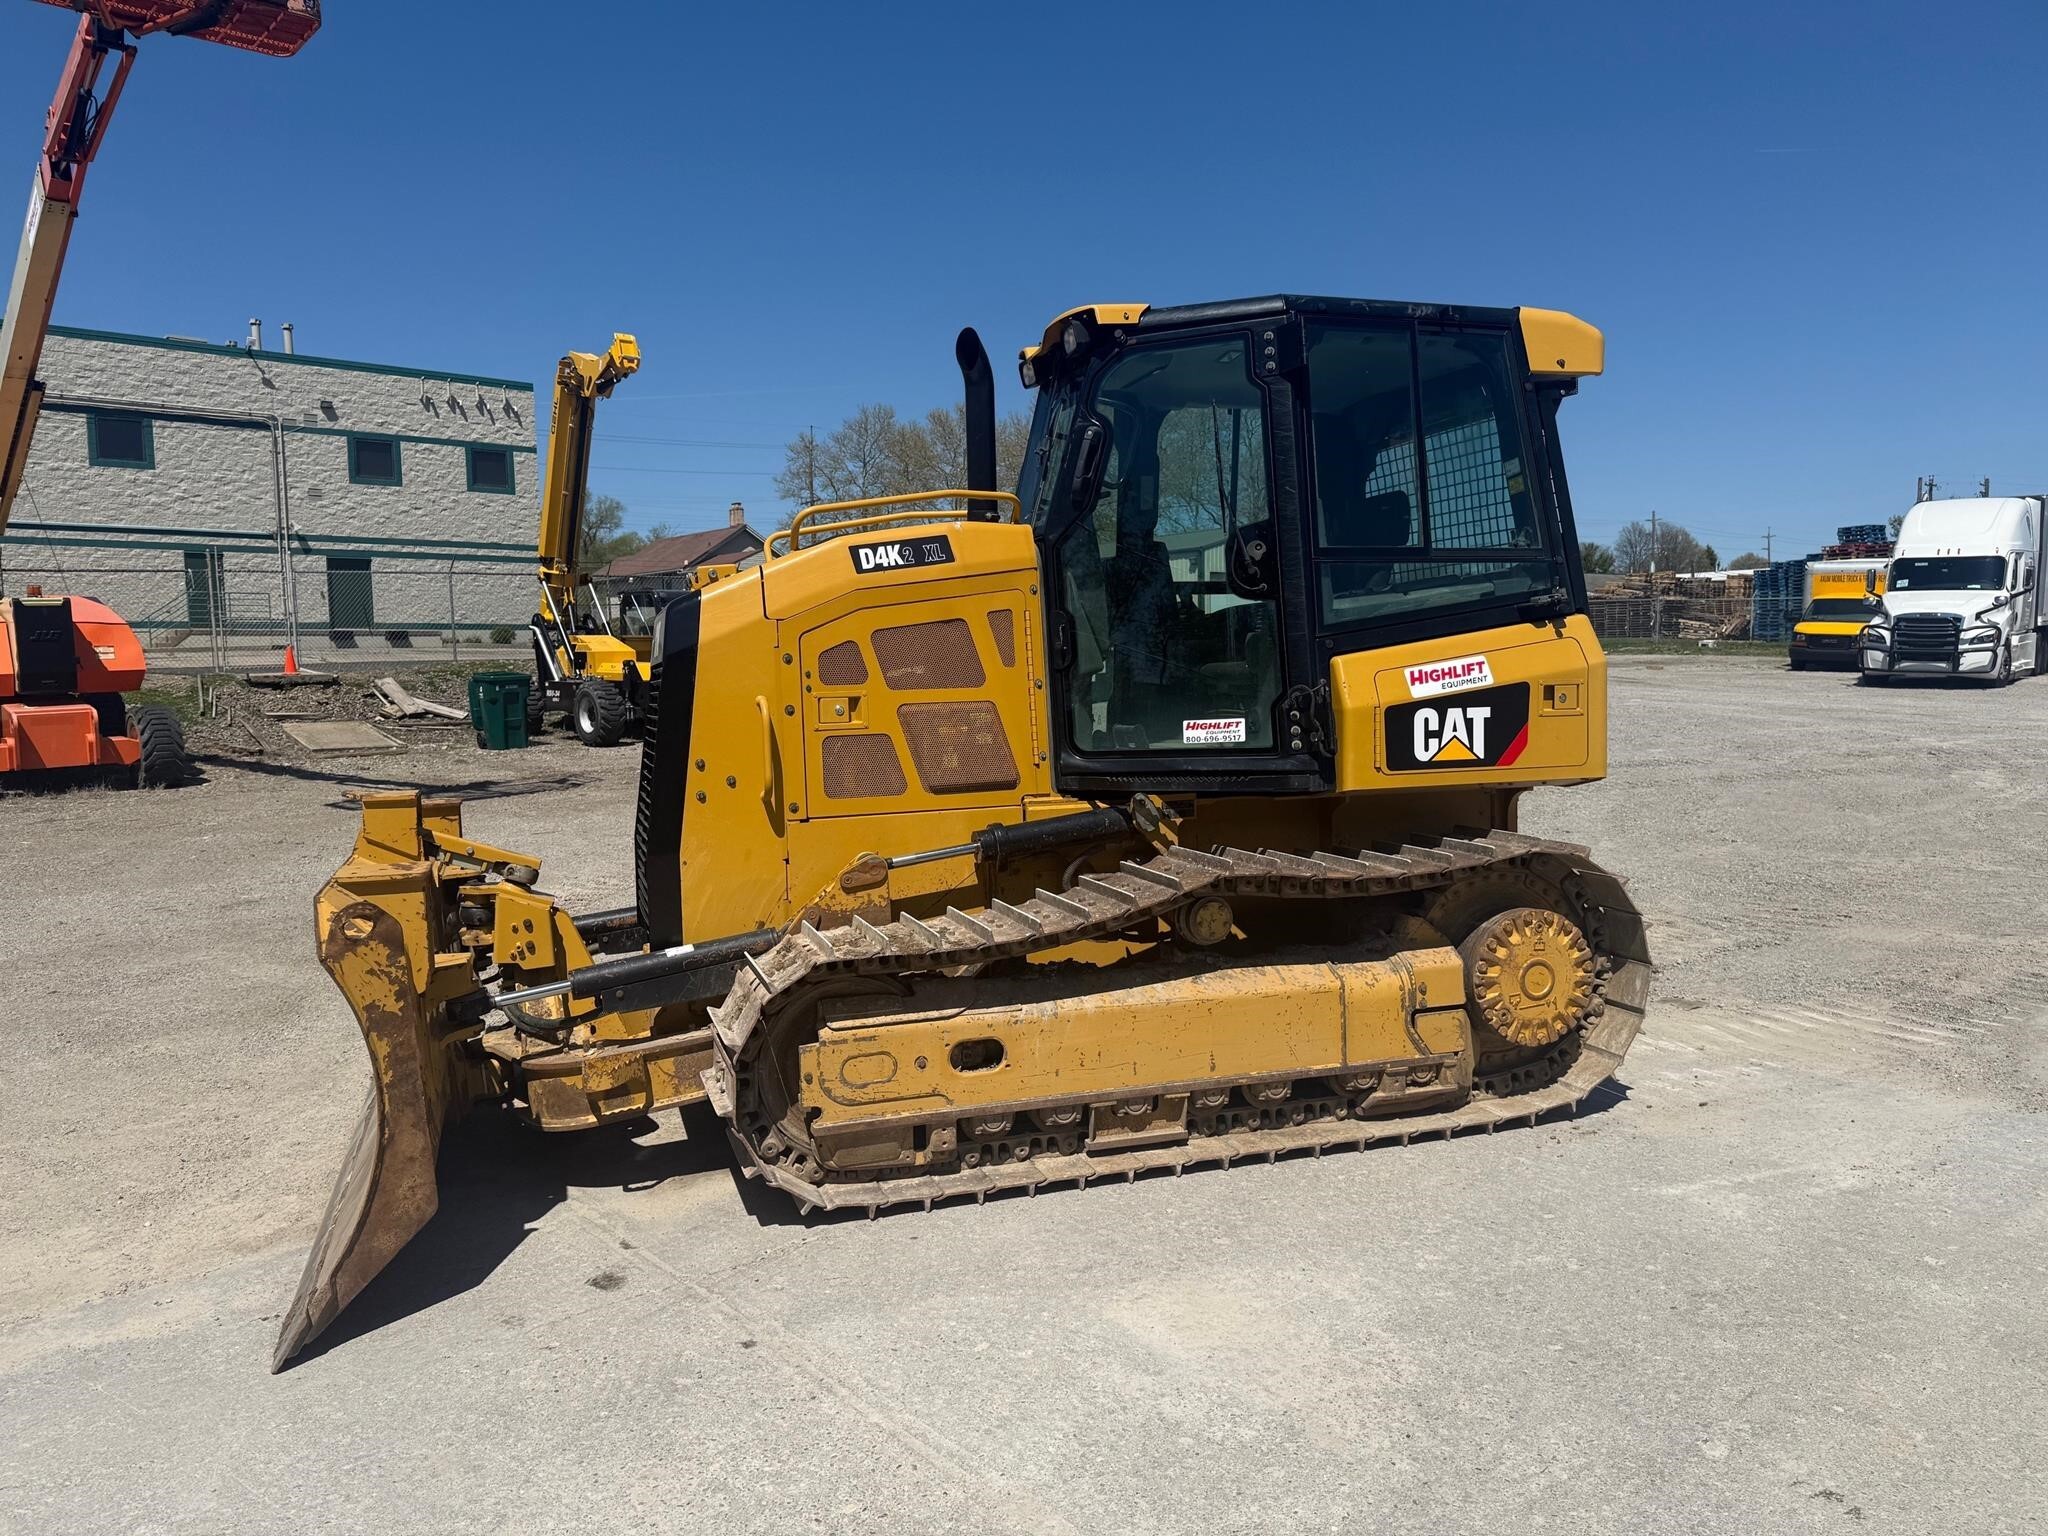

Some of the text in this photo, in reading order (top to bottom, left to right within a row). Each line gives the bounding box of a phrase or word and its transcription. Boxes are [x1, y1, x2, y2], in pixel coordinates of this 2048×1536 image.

[922, 543, 946, 562] XL
[1847, 574, 1859, 582] TRUCK
[1409, 661, 1485, 686] HIGHLIFT
[1441, 675, 1488, 690] EQUIPMENT
[1185, 721, 1242, 730] HIGHLIFT
[1185, 734, 1242, 743] 800-696-9517
[1413, 706, 1492, 762] CAT
